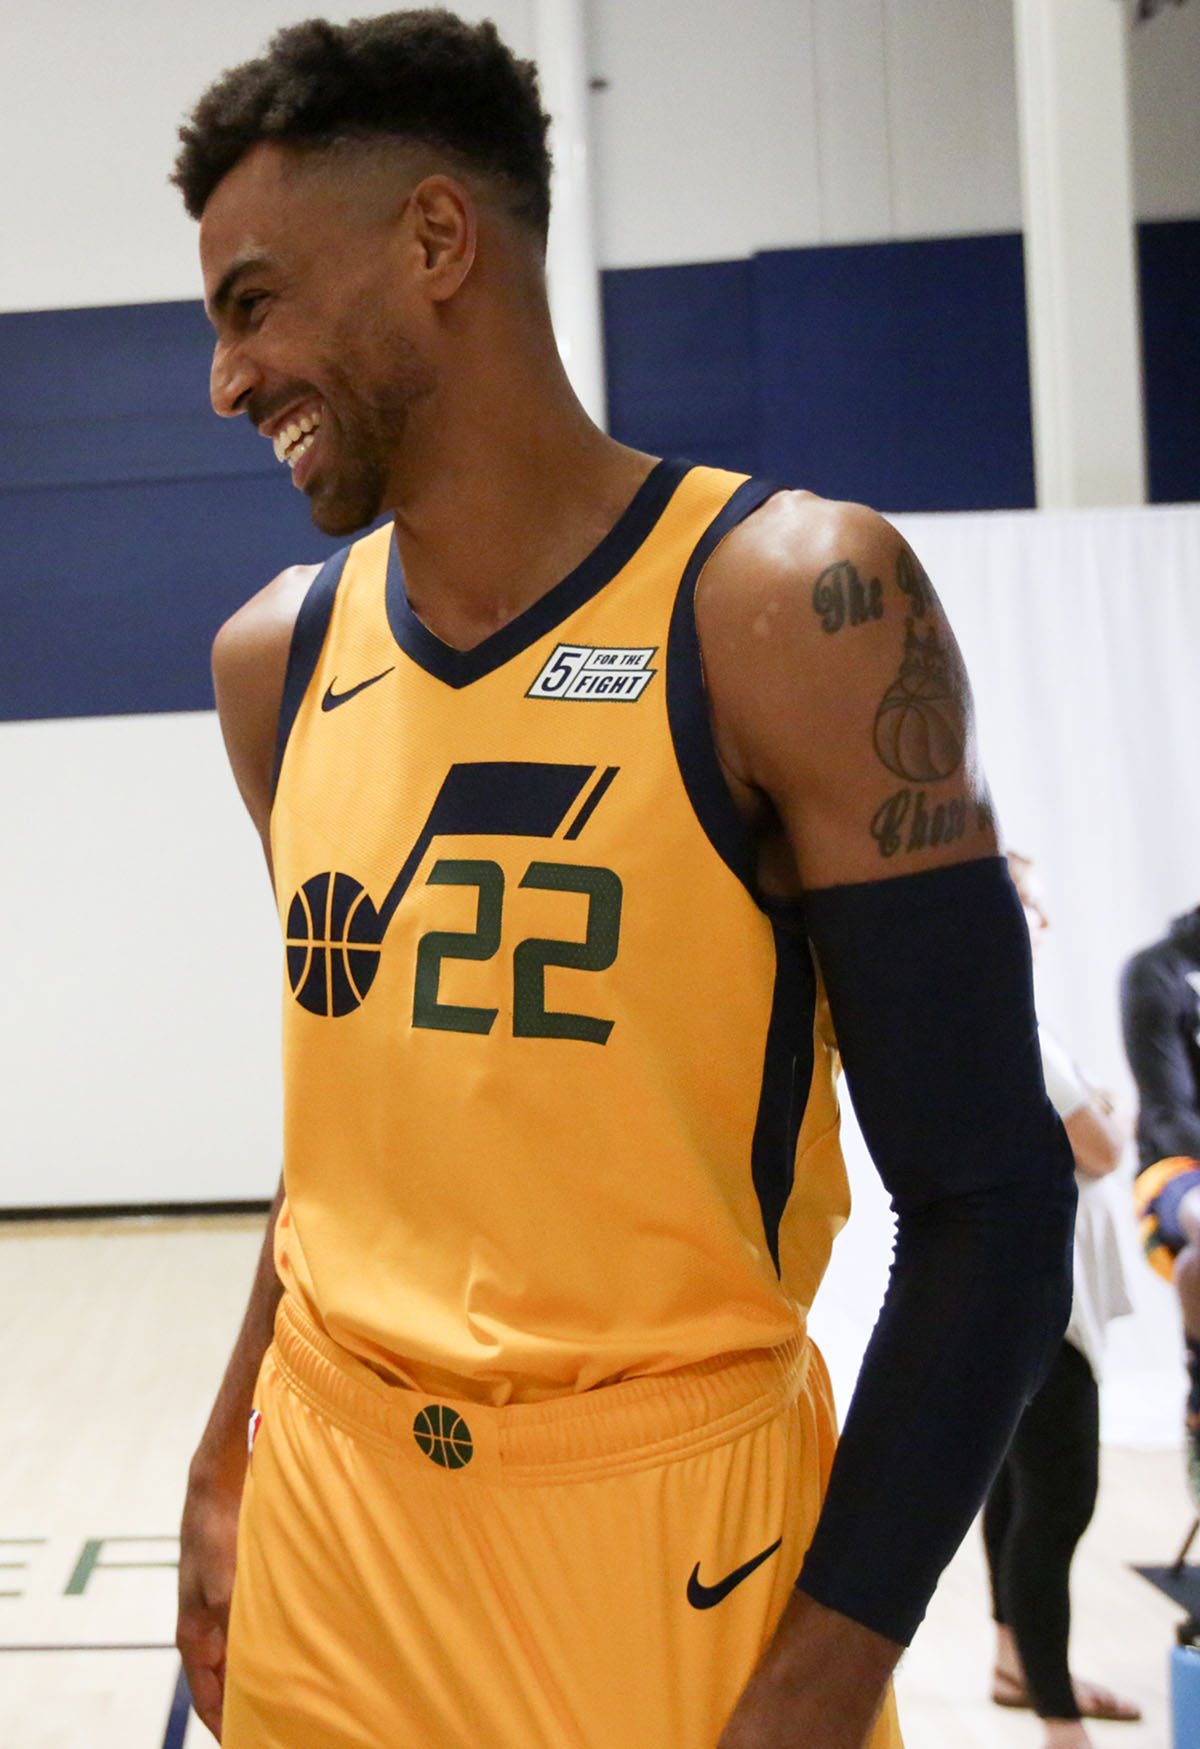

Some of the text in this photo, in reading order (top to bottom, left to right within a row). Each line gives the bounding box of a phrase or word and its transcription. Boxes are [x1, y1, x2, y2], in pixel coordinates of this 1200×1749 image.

[541, 652, 581, 692] 5
[593, 654, 644, 665] FOR THE
[574, 676, 643, 694] FIGHT
[412, 860, 623, 1046] 22
